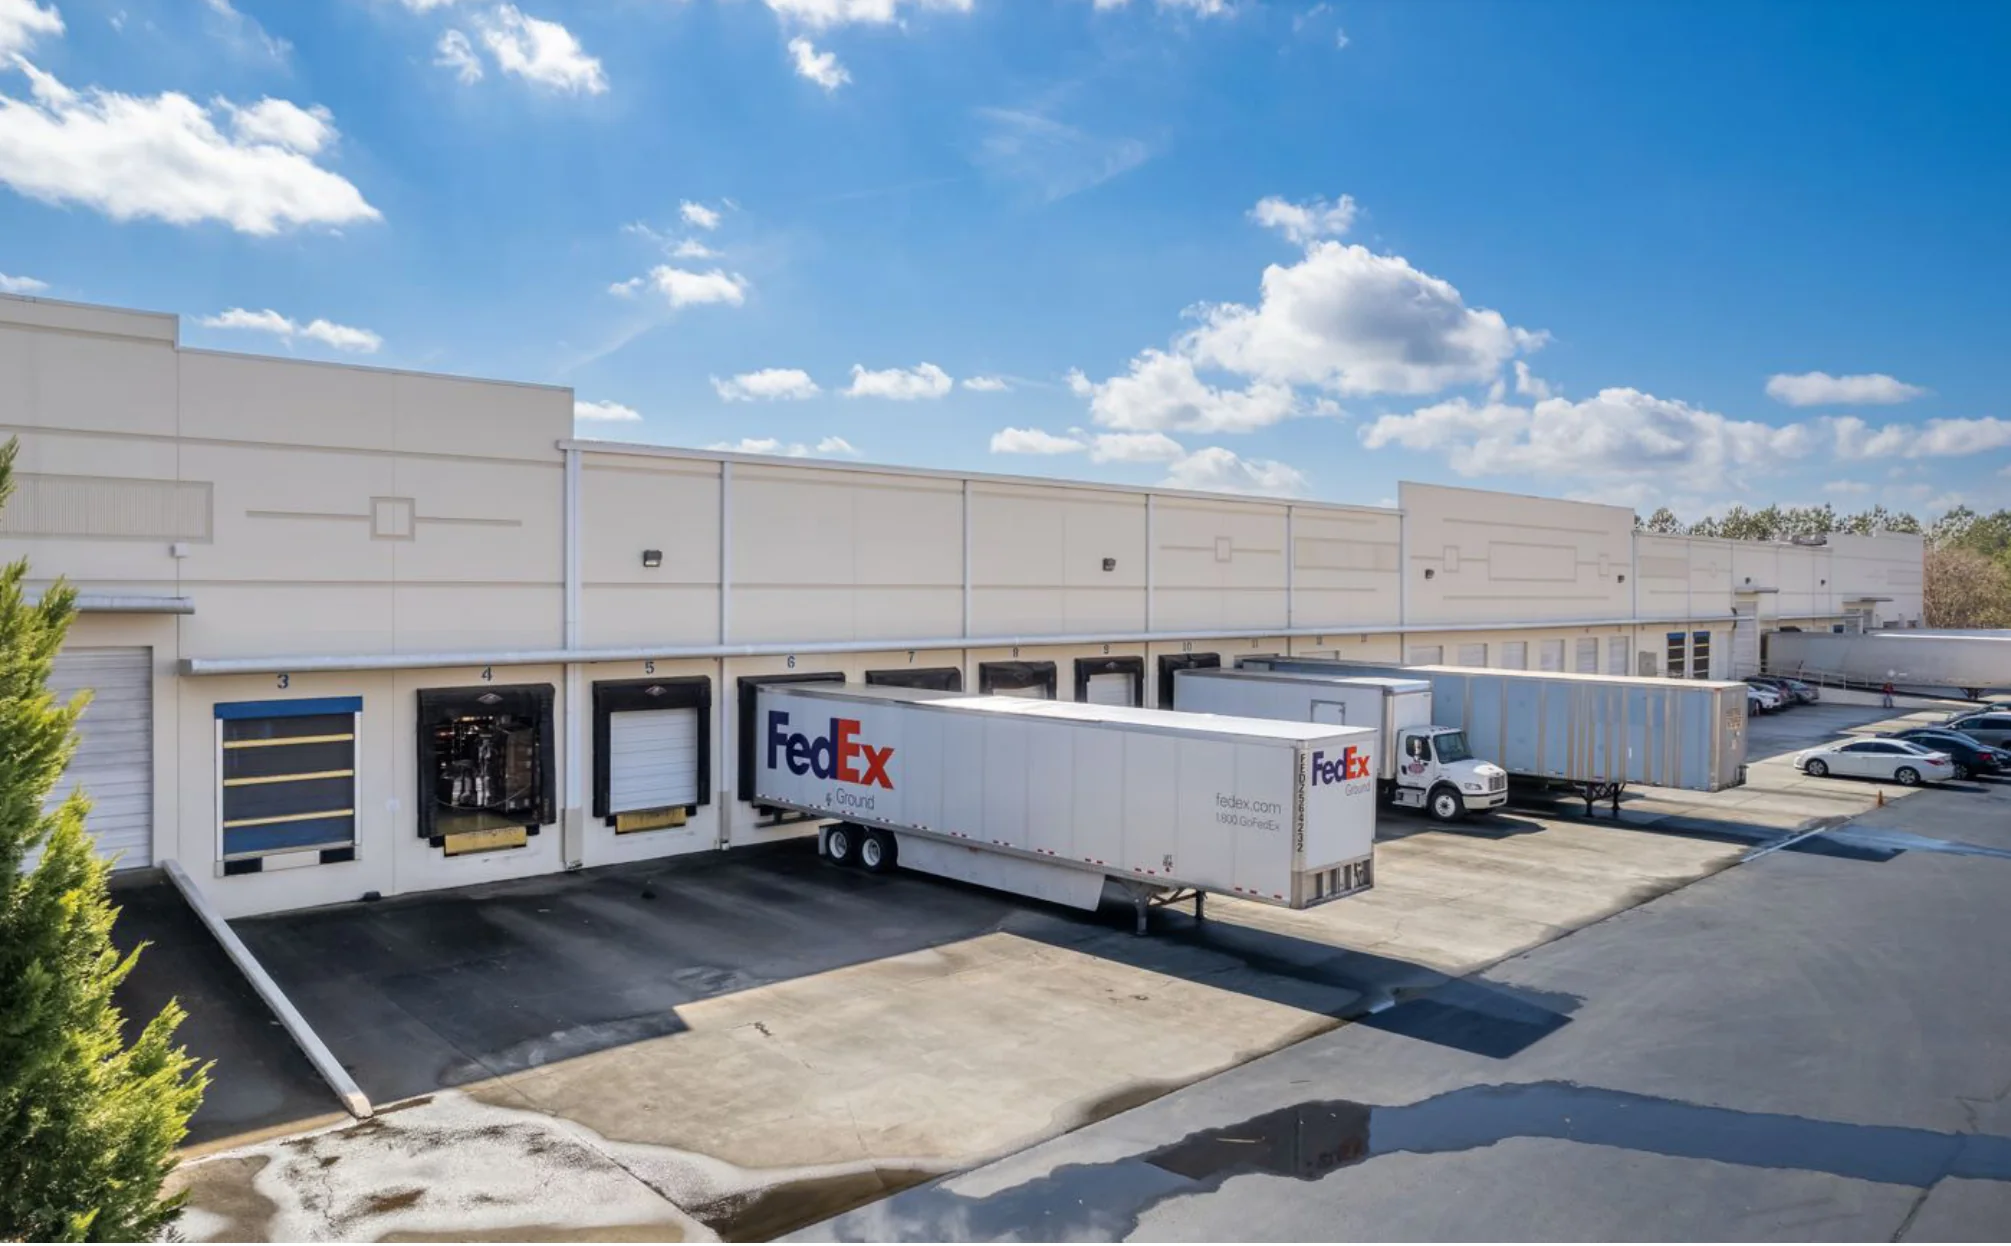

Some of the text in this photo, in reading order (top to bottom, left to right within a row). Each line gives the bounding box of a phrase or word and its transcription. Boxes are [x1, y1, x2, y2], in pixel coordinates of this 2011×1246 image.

[1103, 644, 1109, 654] 9
[1183, 641, 1192, 652] 10
[787, 655, 796, 668] 6
[907, 651, 915, 663] 7
[481, 667, 492, 681] 4
[645, 661, 655, 674] 5
[277, 674, 288, 688] 3
[768, 710, 895, 790] FedEx
[1312, 745, 1370, 786] FedEx
[1345, 783, 1371, 797] Ground
[836, 787, 874, 810] Ground
[1215, 792, 1281, 814] fedex.com
